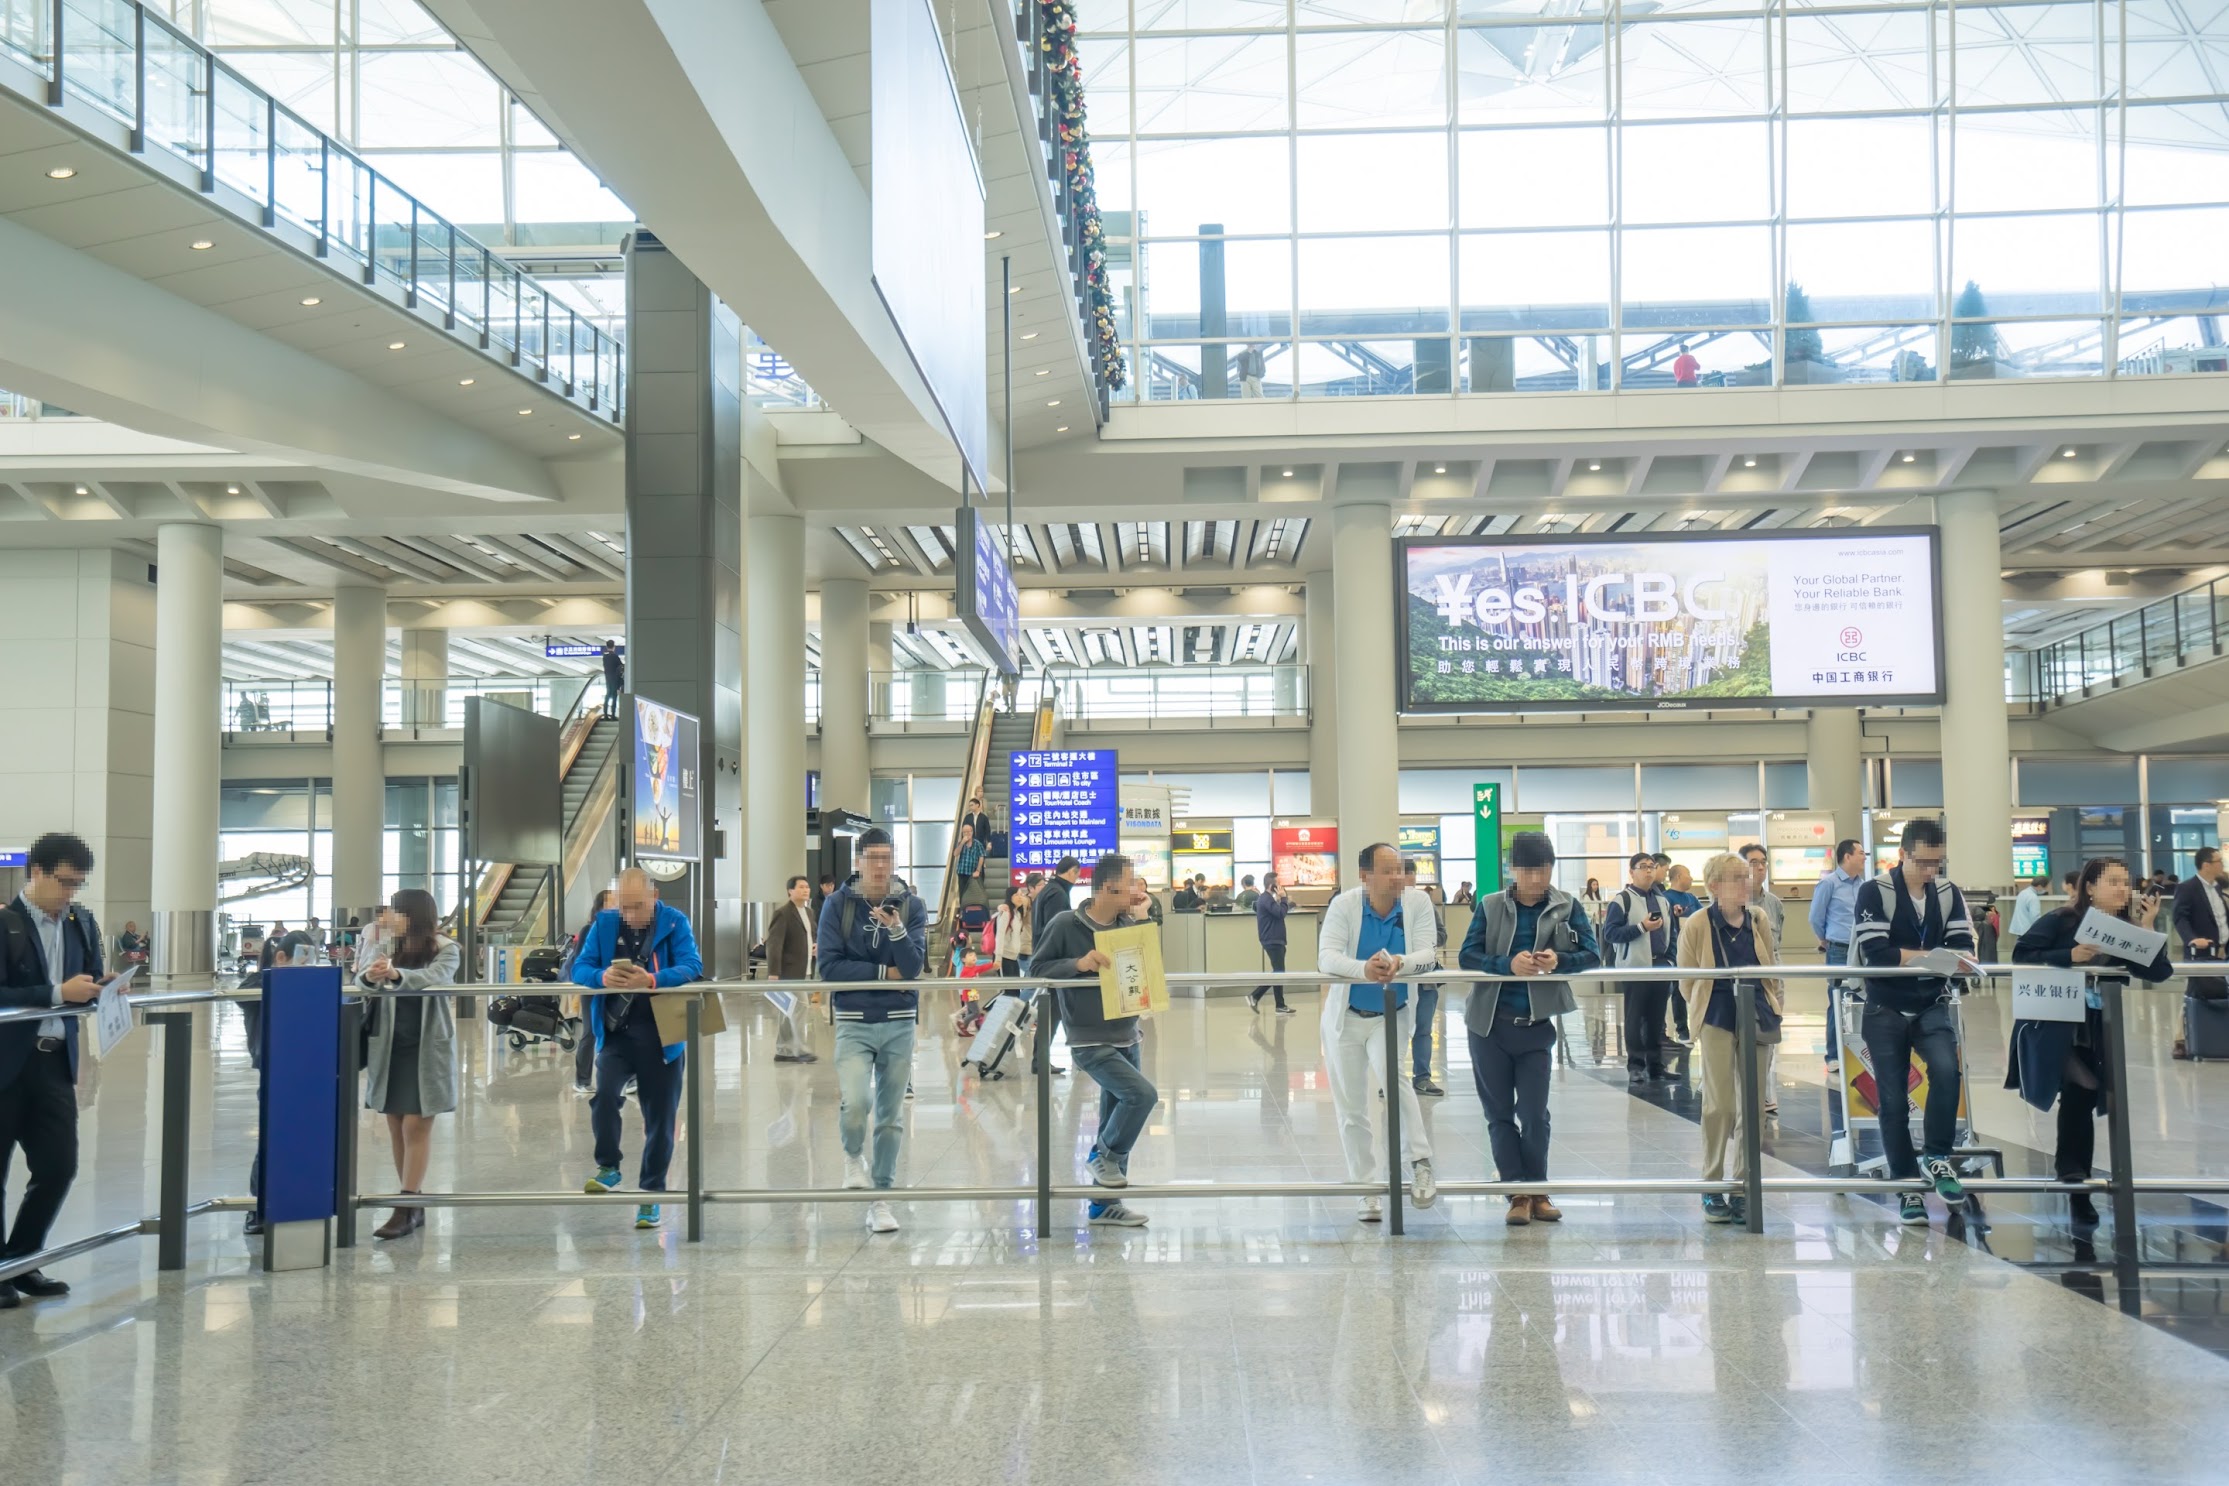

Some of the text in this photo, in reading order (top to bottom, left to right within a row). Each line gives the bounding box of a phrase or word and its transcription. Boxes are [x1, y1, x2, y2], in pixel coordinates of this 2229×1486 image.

[1838, 549, 1904, 557] www.icbcasia.com
[1793, 573, 1905, 585] Your Global Partner.
[1793, 587, 1905, 599] Your Reliable Bank.
[1438, 636, 1472, 652] This
[1475, 636, 1488, 651] is
[1493, 639, 1520, 651] our
[1524, 637, 1579, 650] answer
[1582, 635, 1605, 650] for
[1609, 638, 1645, 653] your
[1648, 634, 1685, 649] RMB
[1837, 652, 1867, 662] ICBC
[1812, 670, 1894, 684] 中国工商银行
[1072, 771, 1099, 780] 往市區
[1080, 780, 1092, 788] city
[1074, 838, 1097, 846] Lounge
[2018, 984, 2079, 999] 兴业银行
